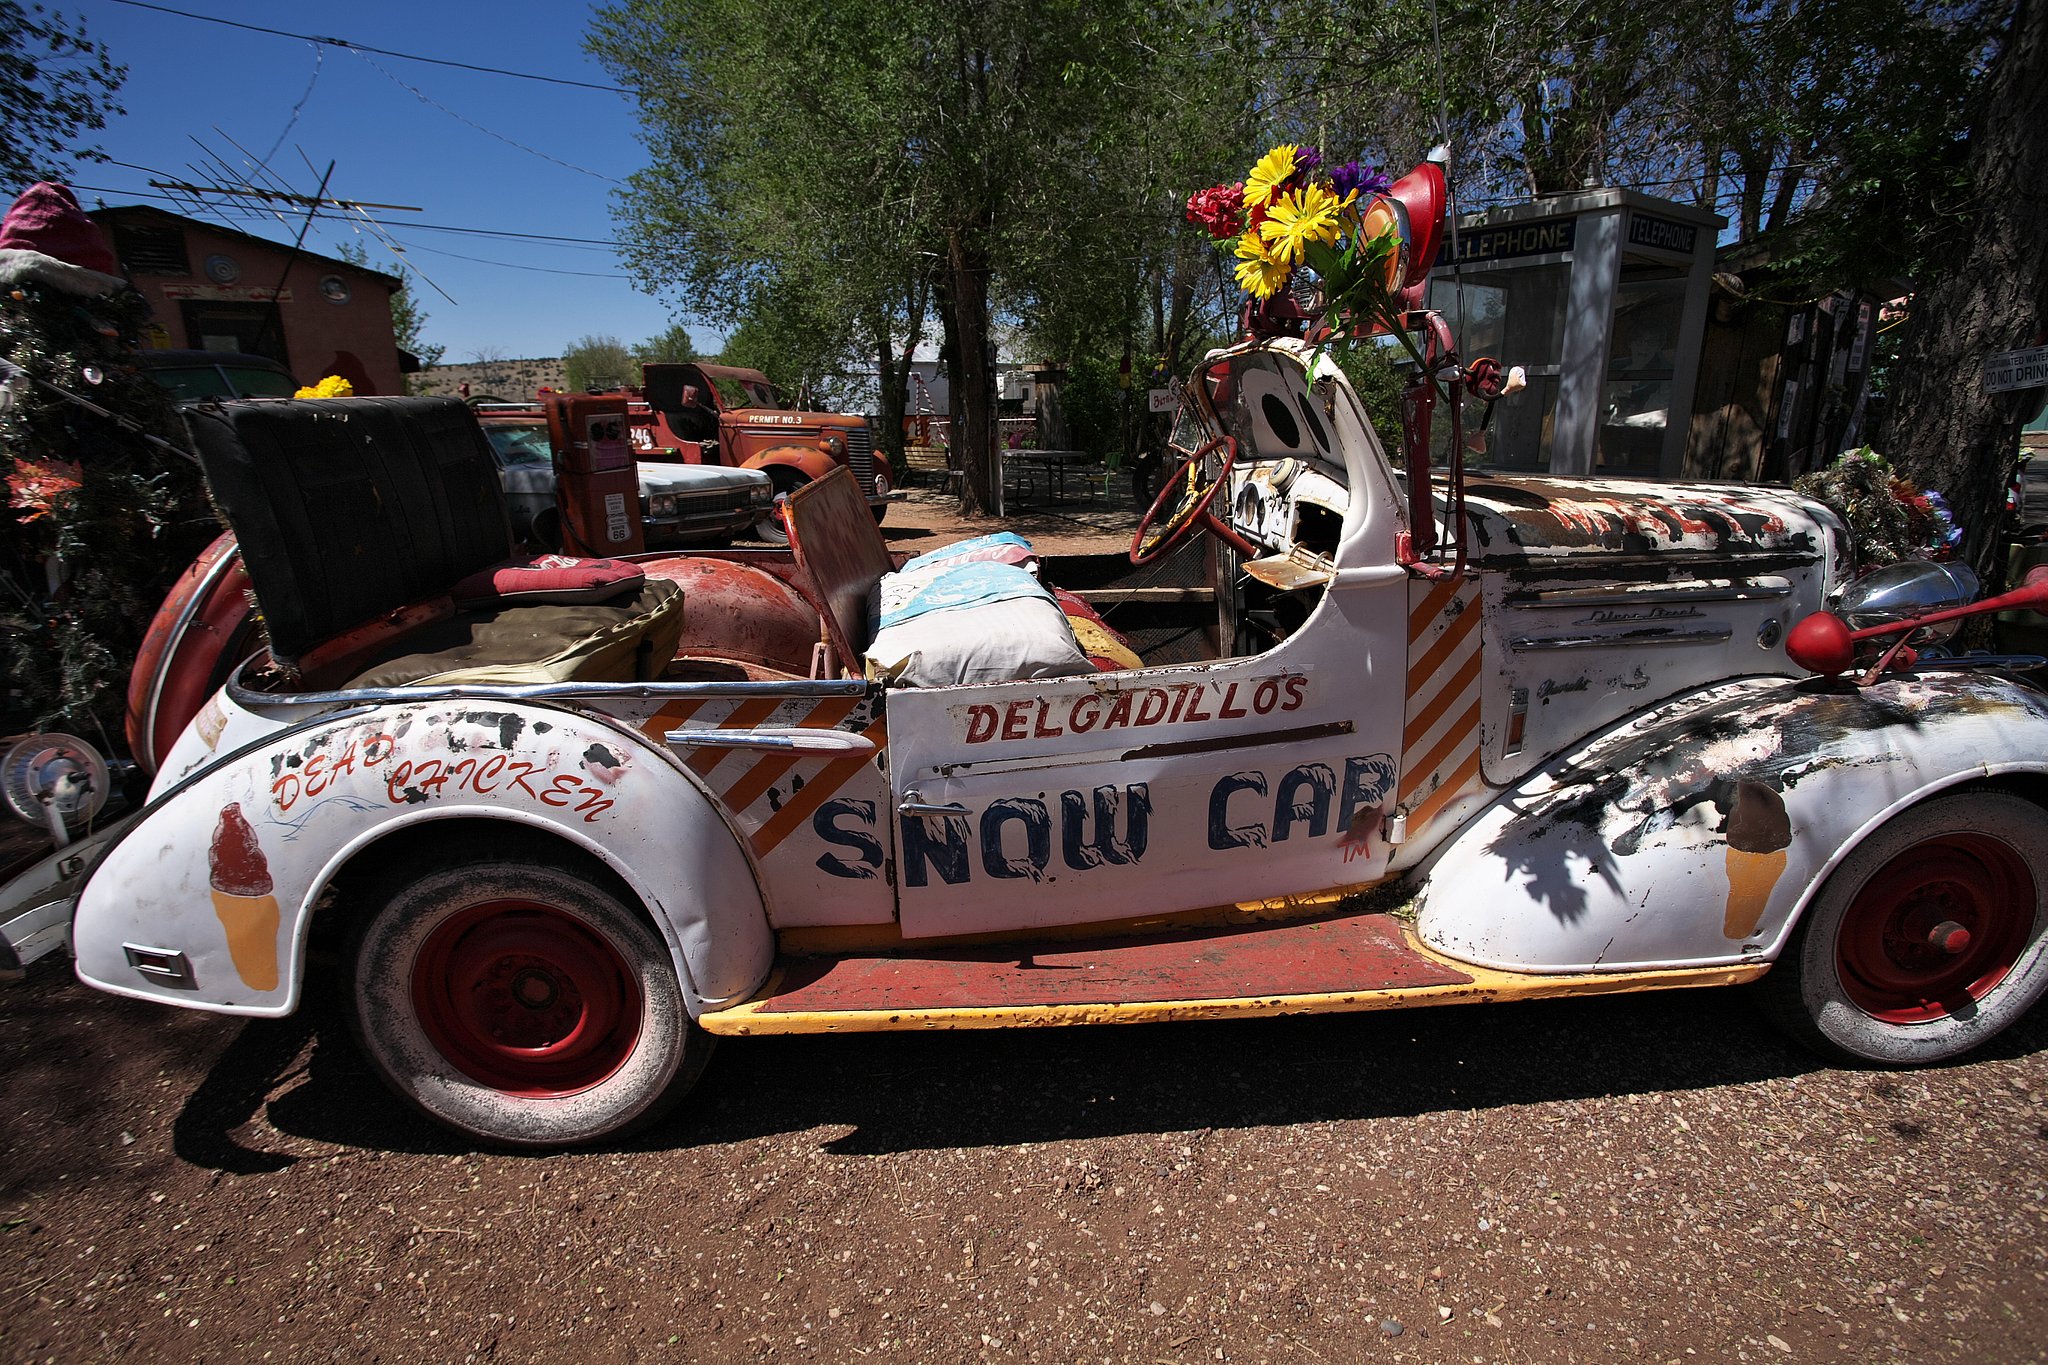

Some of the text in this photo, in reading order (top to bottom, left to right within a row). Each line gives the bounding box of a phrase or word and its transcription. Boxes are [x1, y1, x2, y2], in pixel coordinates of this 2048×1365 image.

[1440, 223, 1571, 262] TELEPHONE
[1632, 217, 1694, 251] TELEPHONE
[1986, 371, 1997, 386] DO
[1998, 369, 2013, 384] NOT
[748, 415, 780, 424] PERMIT
[613, 530, 625, 540] 66
[271, 734, 614, 823] DEAD CHICKEN
[813, 752, 1397, 887] SNOW CAP
[1337, 839, 1371, 864] TM
